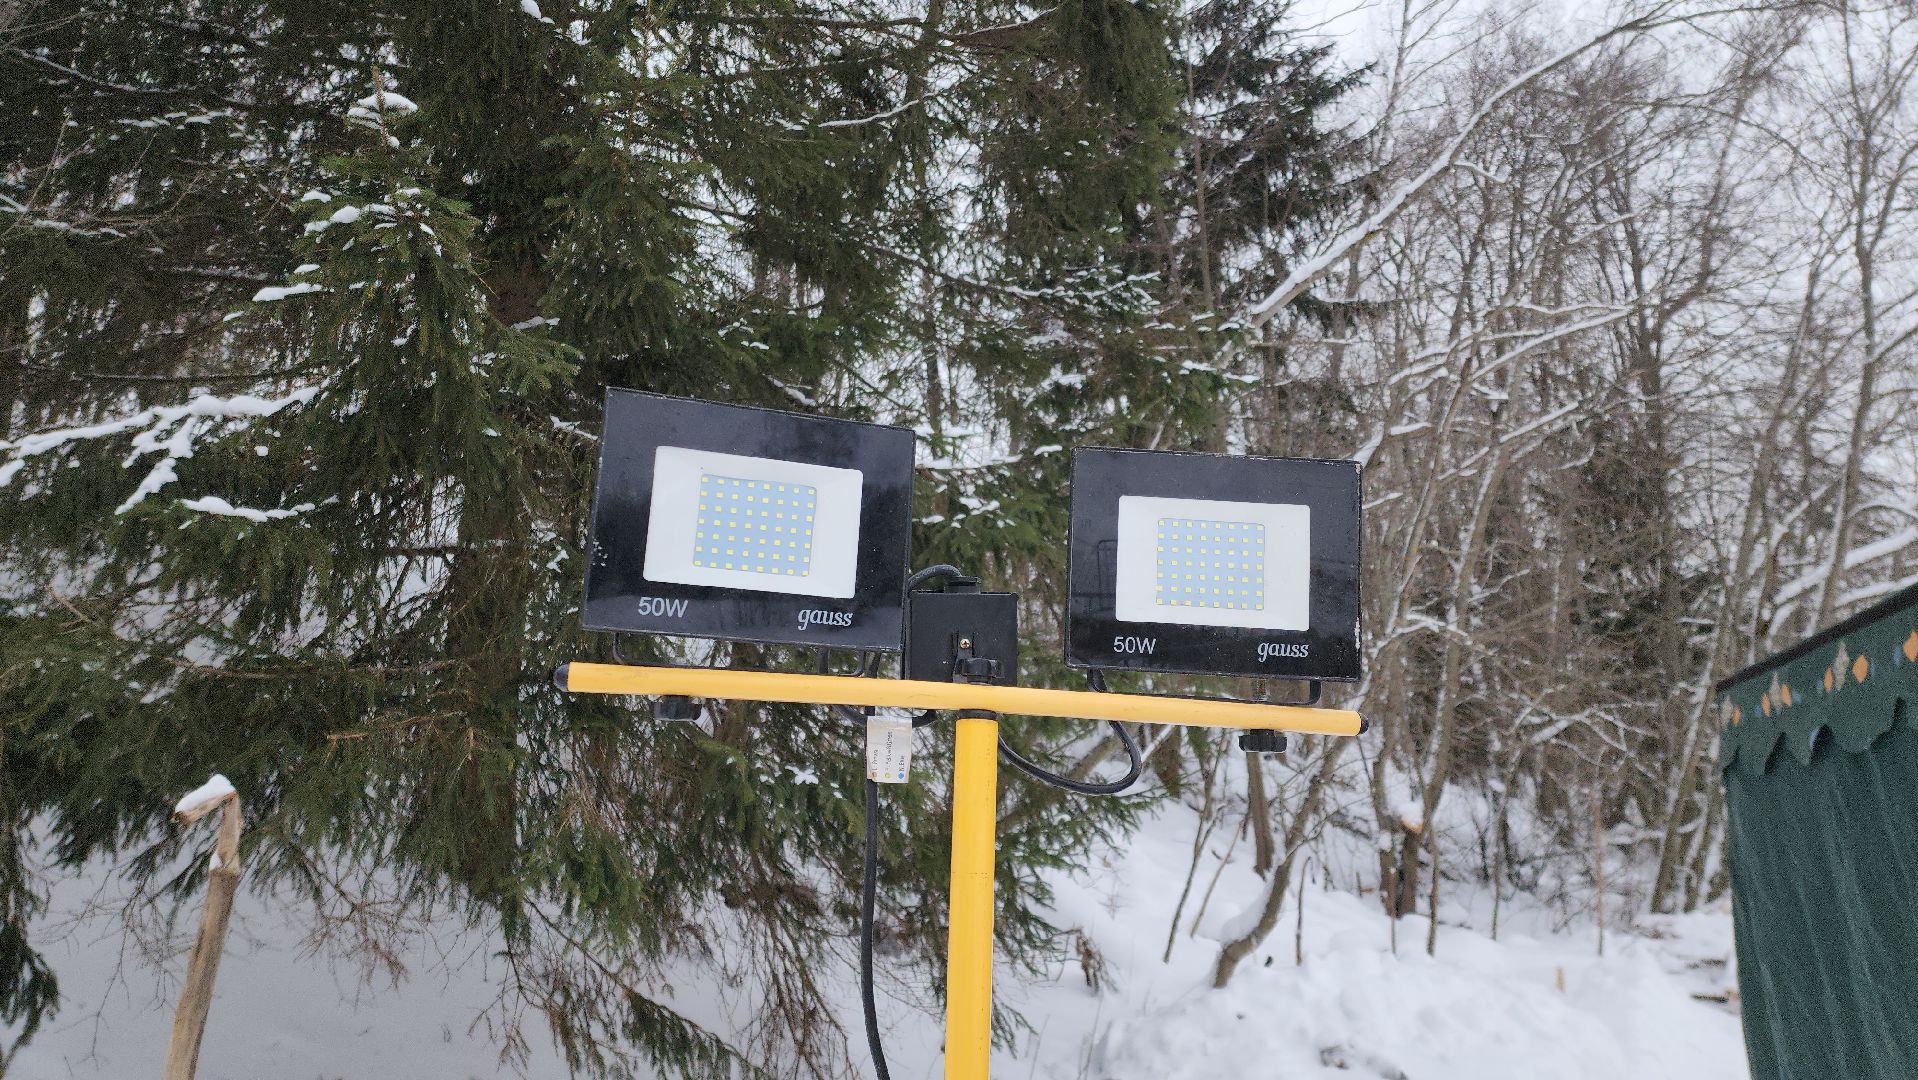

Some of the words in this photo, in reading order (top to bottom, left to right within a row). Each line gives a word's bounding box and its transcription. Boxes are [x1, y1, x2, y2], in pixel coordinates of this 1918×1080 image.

[637, 596, 688, 618] 50W
[797, 608, 853, 631] gauss
[1113, 636, 1157, 655] 50W
[1257, 642, 1309, 663] gauss
